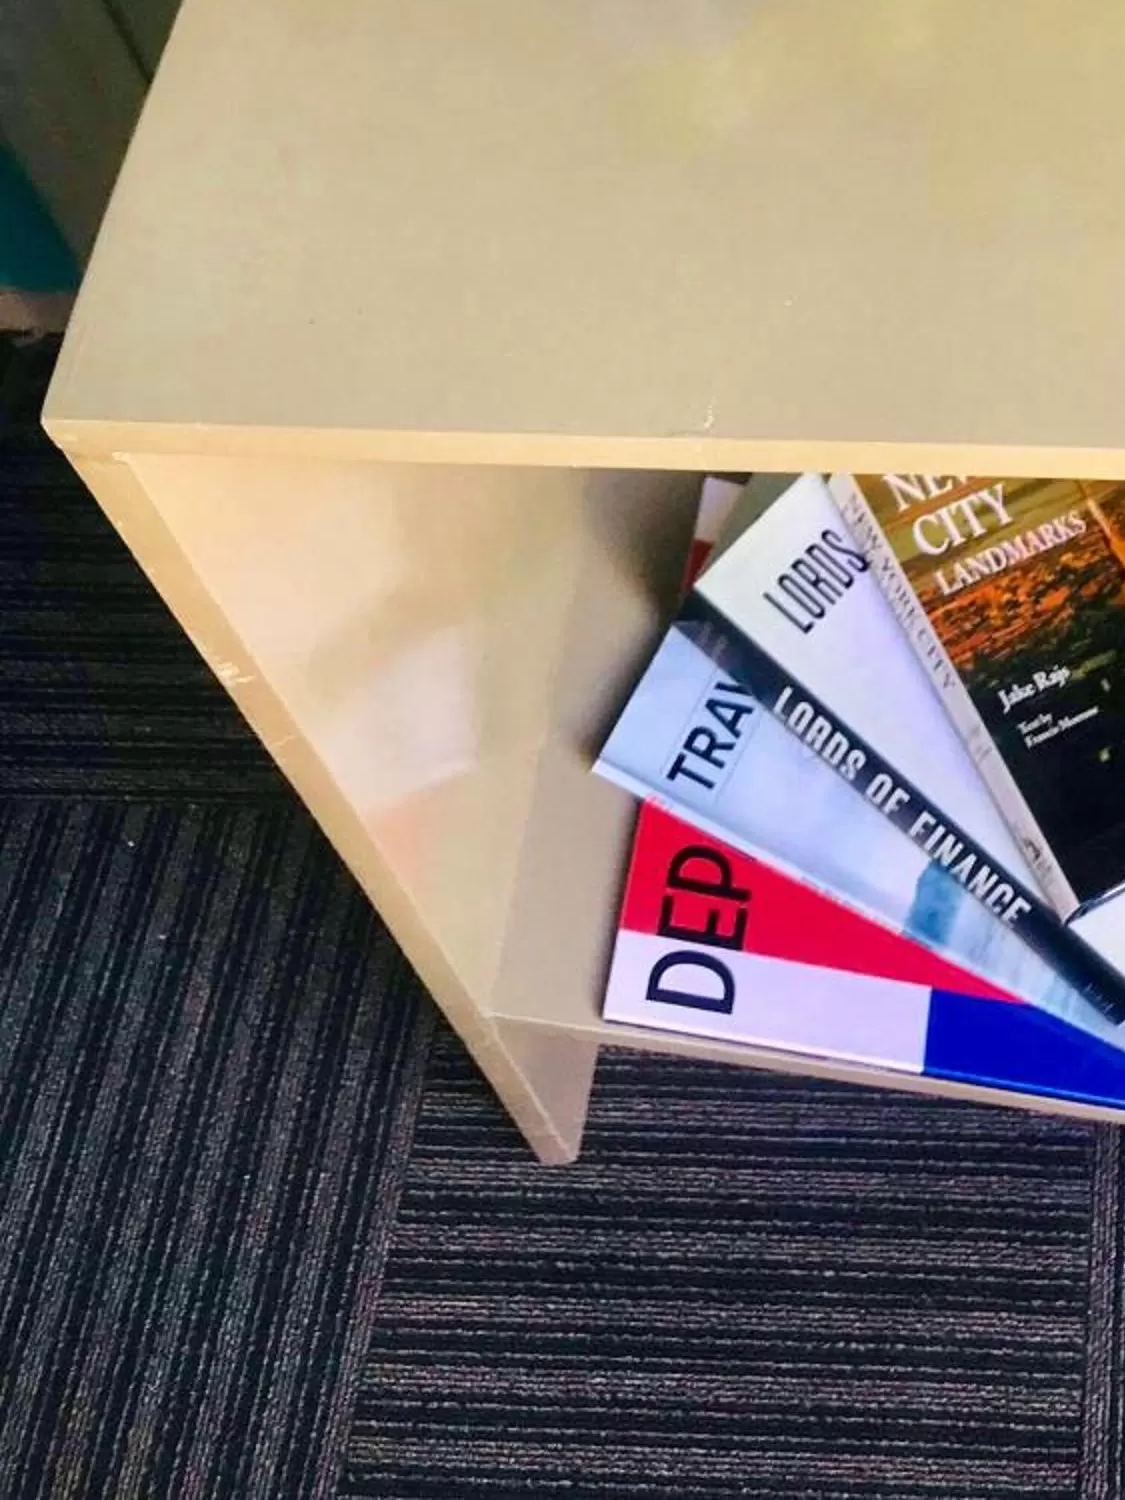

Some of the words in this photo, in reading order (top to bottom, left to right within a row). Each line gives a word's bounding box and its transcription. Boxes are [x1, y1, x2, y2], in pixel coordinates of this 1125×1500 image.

[883, 474, 969, 511] NE
[911, 483, 1014, 555] CITY
[763, 528, 870, 634] LORDS
[934, 509, 1087, 596] LANDMARKS
[773, 684, 868, 780] LORDS
[864, 772, 911, 814] OF
[907, 809, 1032, 925] FINANCE
